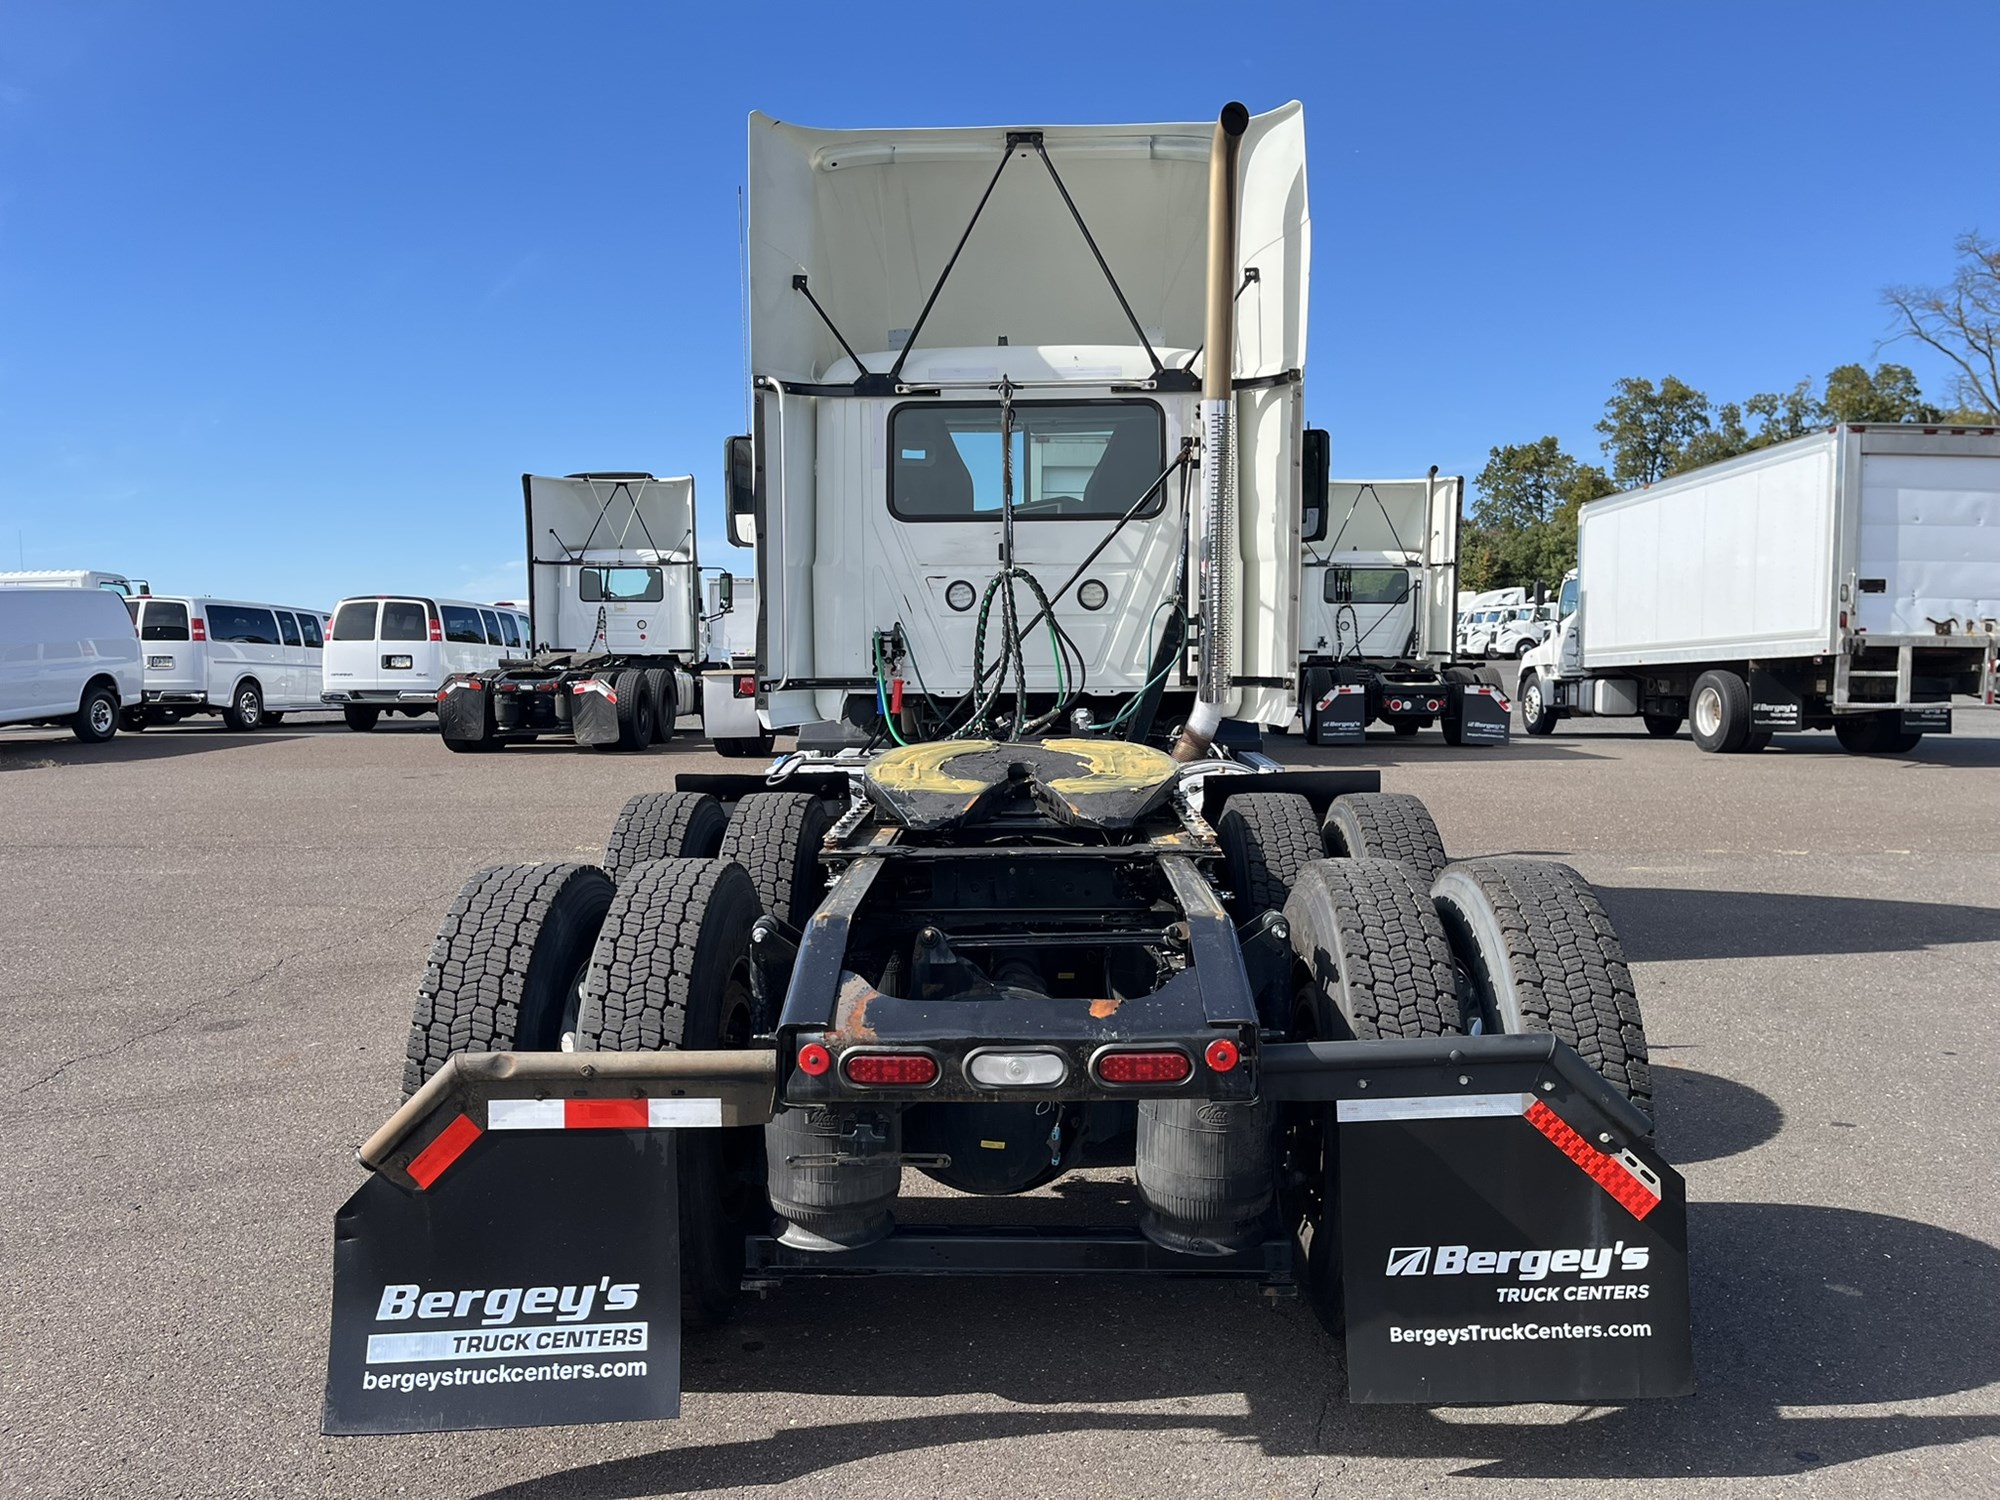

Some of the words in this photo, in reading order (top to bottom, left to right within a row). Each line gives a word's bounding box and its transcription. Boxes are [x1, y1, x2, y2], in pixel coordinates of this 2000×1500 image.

[1433, 1240, 1649, 1281] Bergey's
[375, 1276, 640, 1326] Bergey's
[1497, 1287, 1560, 1303] TRUCK
[1563, 1284, 1650, 1301] CENTERS
[453, 1332, 530, 1354] TRUCK
[536, 1329, 643, 1350] CENTERS
[1390, 1322, 1652, 1345] BergeysTruckCenters.com
[363, 1361, 647, 1392] bergeystruckcenters.com
